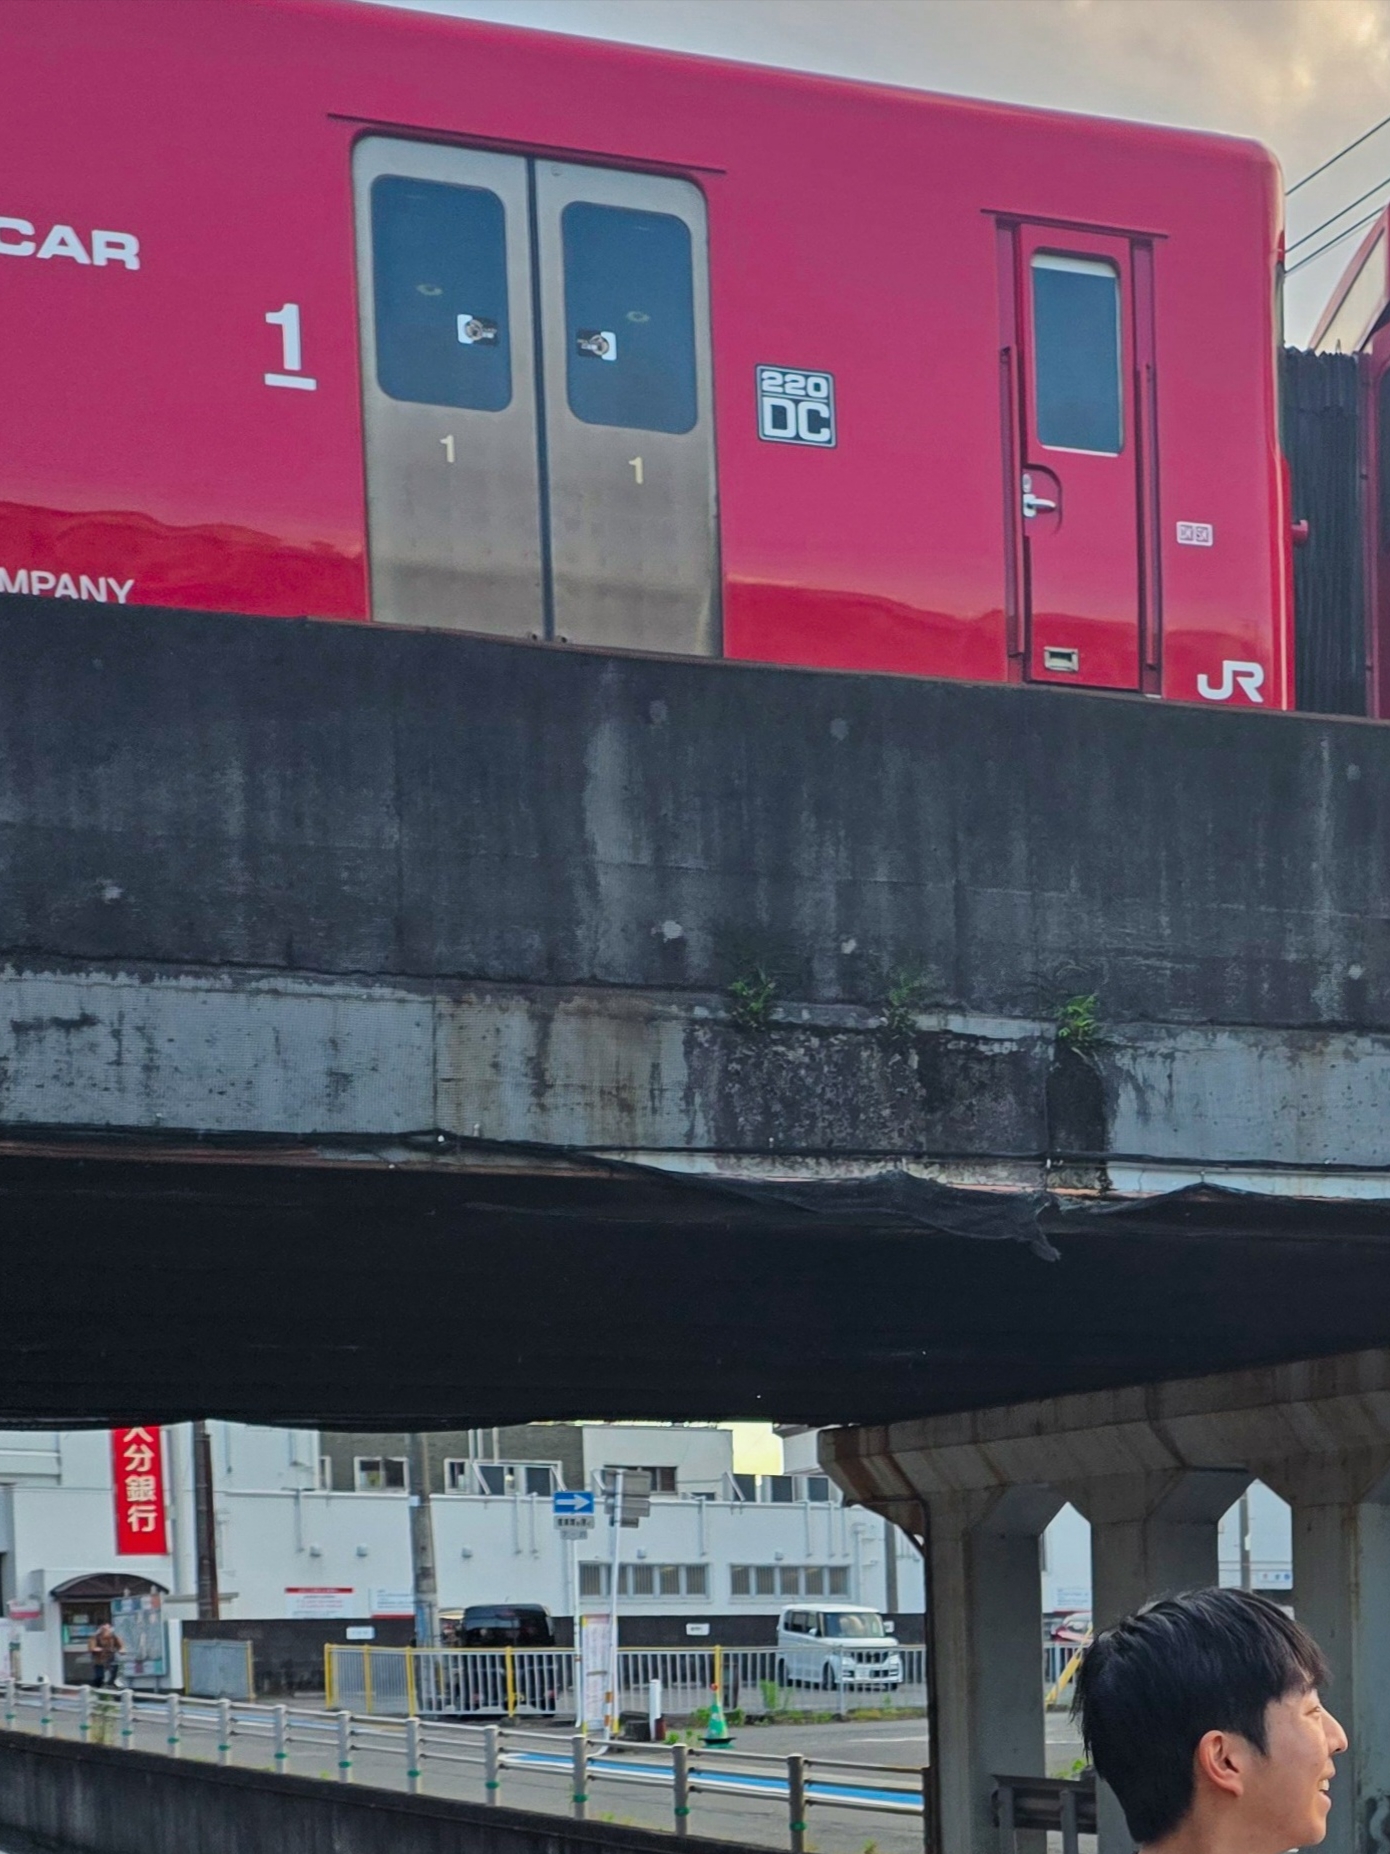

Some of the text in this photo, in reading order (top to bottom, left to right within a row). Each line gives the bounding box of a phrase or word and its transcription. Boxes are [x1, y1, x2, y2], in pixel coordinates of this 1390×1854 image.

[0, 216, 140, 271] CAR
[265, 303, 302, 371] 1
[761, 370, 829, 398] 220
[762, 396, 831, 442] DC
[440, 434, 455, 463] 1
[628, 456, 644, 485] 1
[1197, 660, 1265, 703] JR
